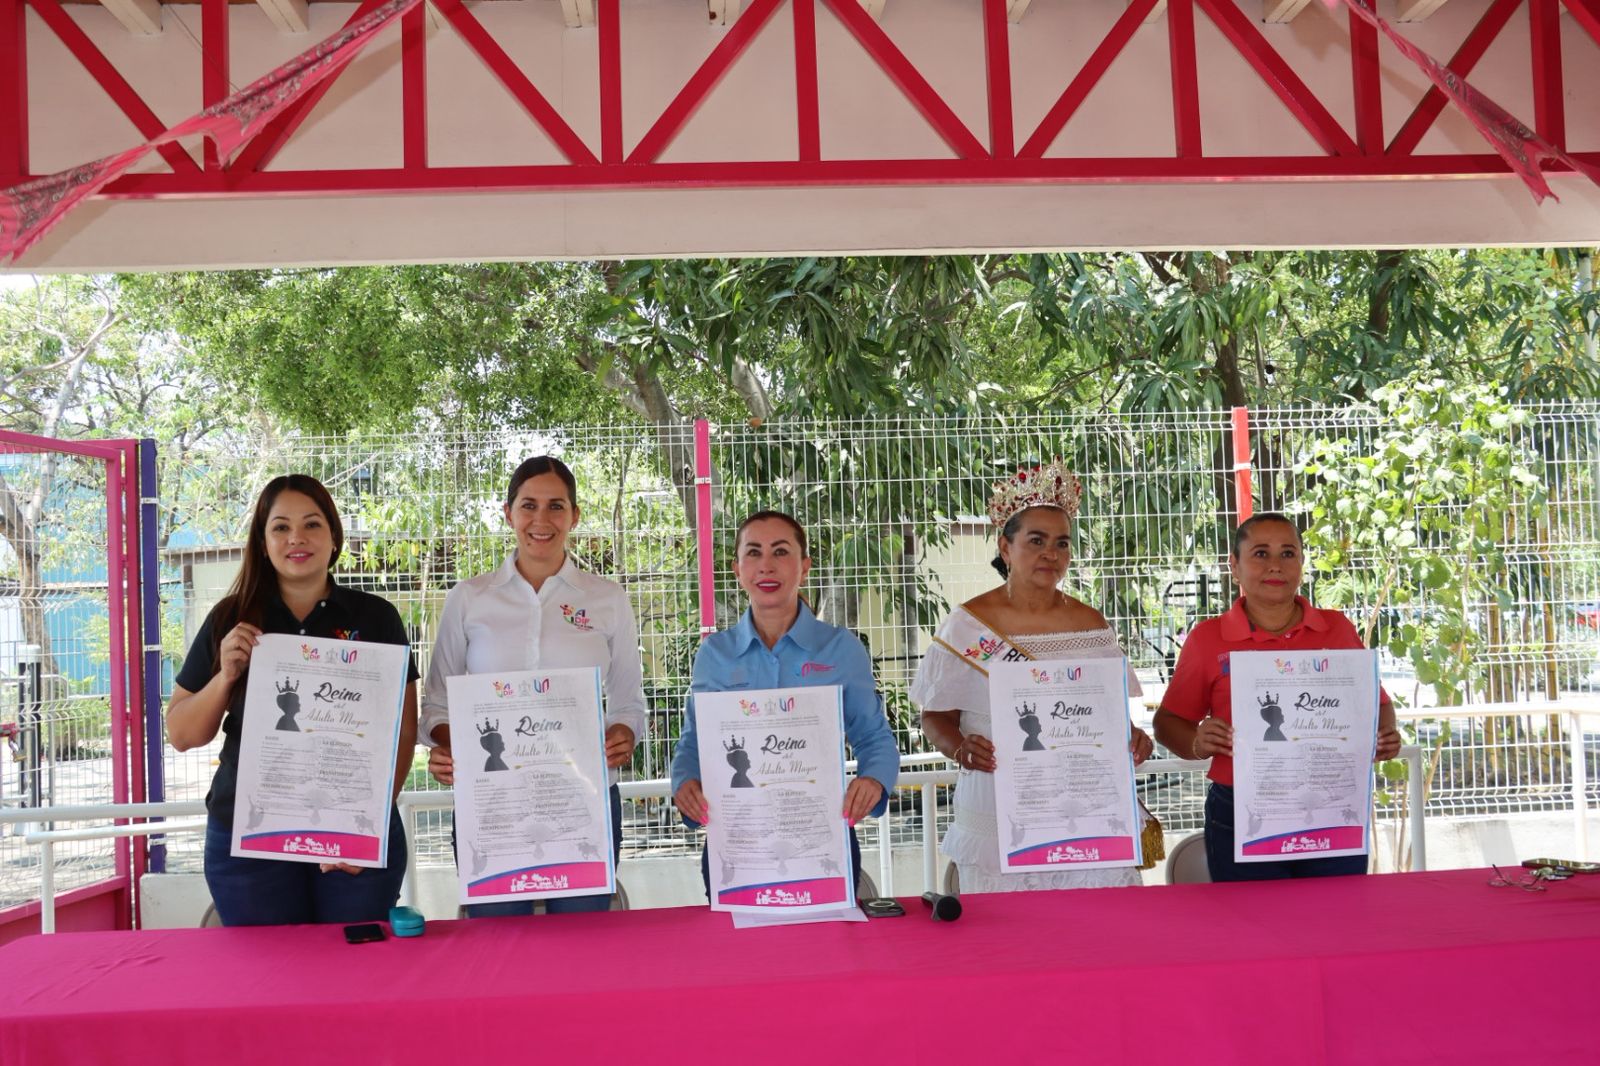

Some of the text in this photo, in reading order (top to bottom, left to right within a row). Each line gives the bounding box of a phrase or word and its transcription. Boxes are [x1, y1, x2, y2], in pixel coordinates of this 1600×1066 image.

[1002, 647, 1030, 662] RE
[313, 682, 362, 703] Reina
[1294, 692, 1340, 711] Reina
[303, 708, 370, 728] Adulto Mayor
[1050, 701, 1092, 719] Reina
[515, 715, 562, 736] Reina
[1048, 725, 1105, 739] Adulto Mayor
[1290, 717, 1351, 733] Adulto Mayor
[760, 734, 807, 755] Reina
[756, 760, 818, 776] Adulto Mayor
